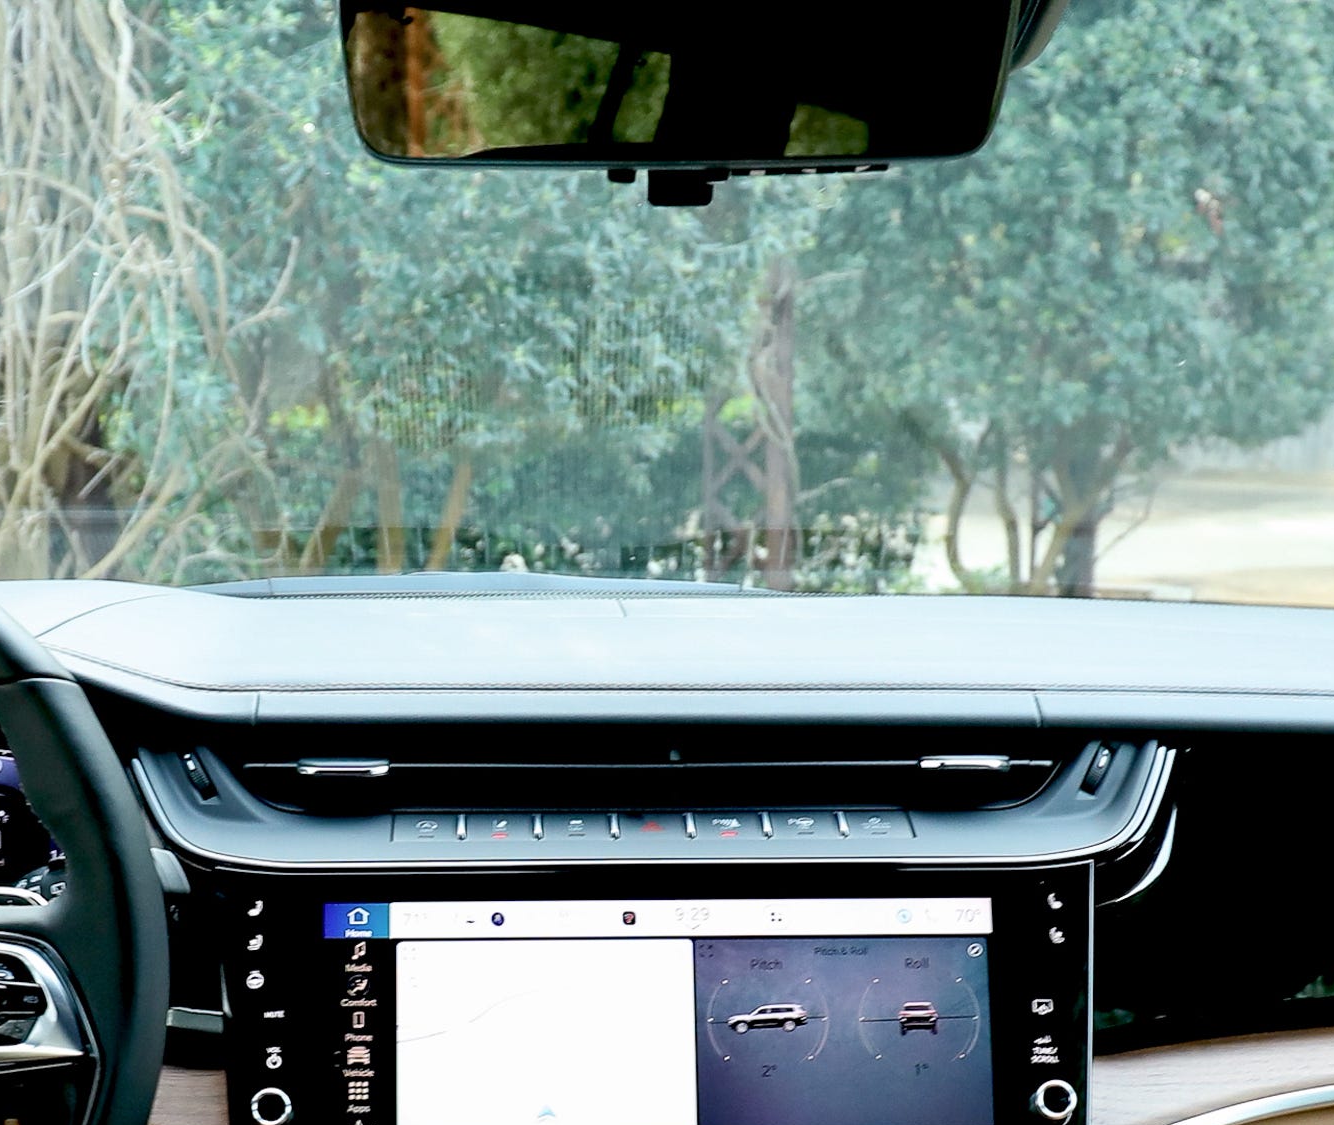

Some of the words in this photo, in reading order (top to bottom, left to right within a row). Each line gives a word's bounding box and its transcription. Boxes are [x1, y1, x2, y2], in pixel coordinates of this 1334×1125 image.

[675, 906, 710, 921] 929
[750, 958, 783, 971] Pitch
[904, 957, 929, 970] Roll
[344, 1033, 373, 1042] Phone
